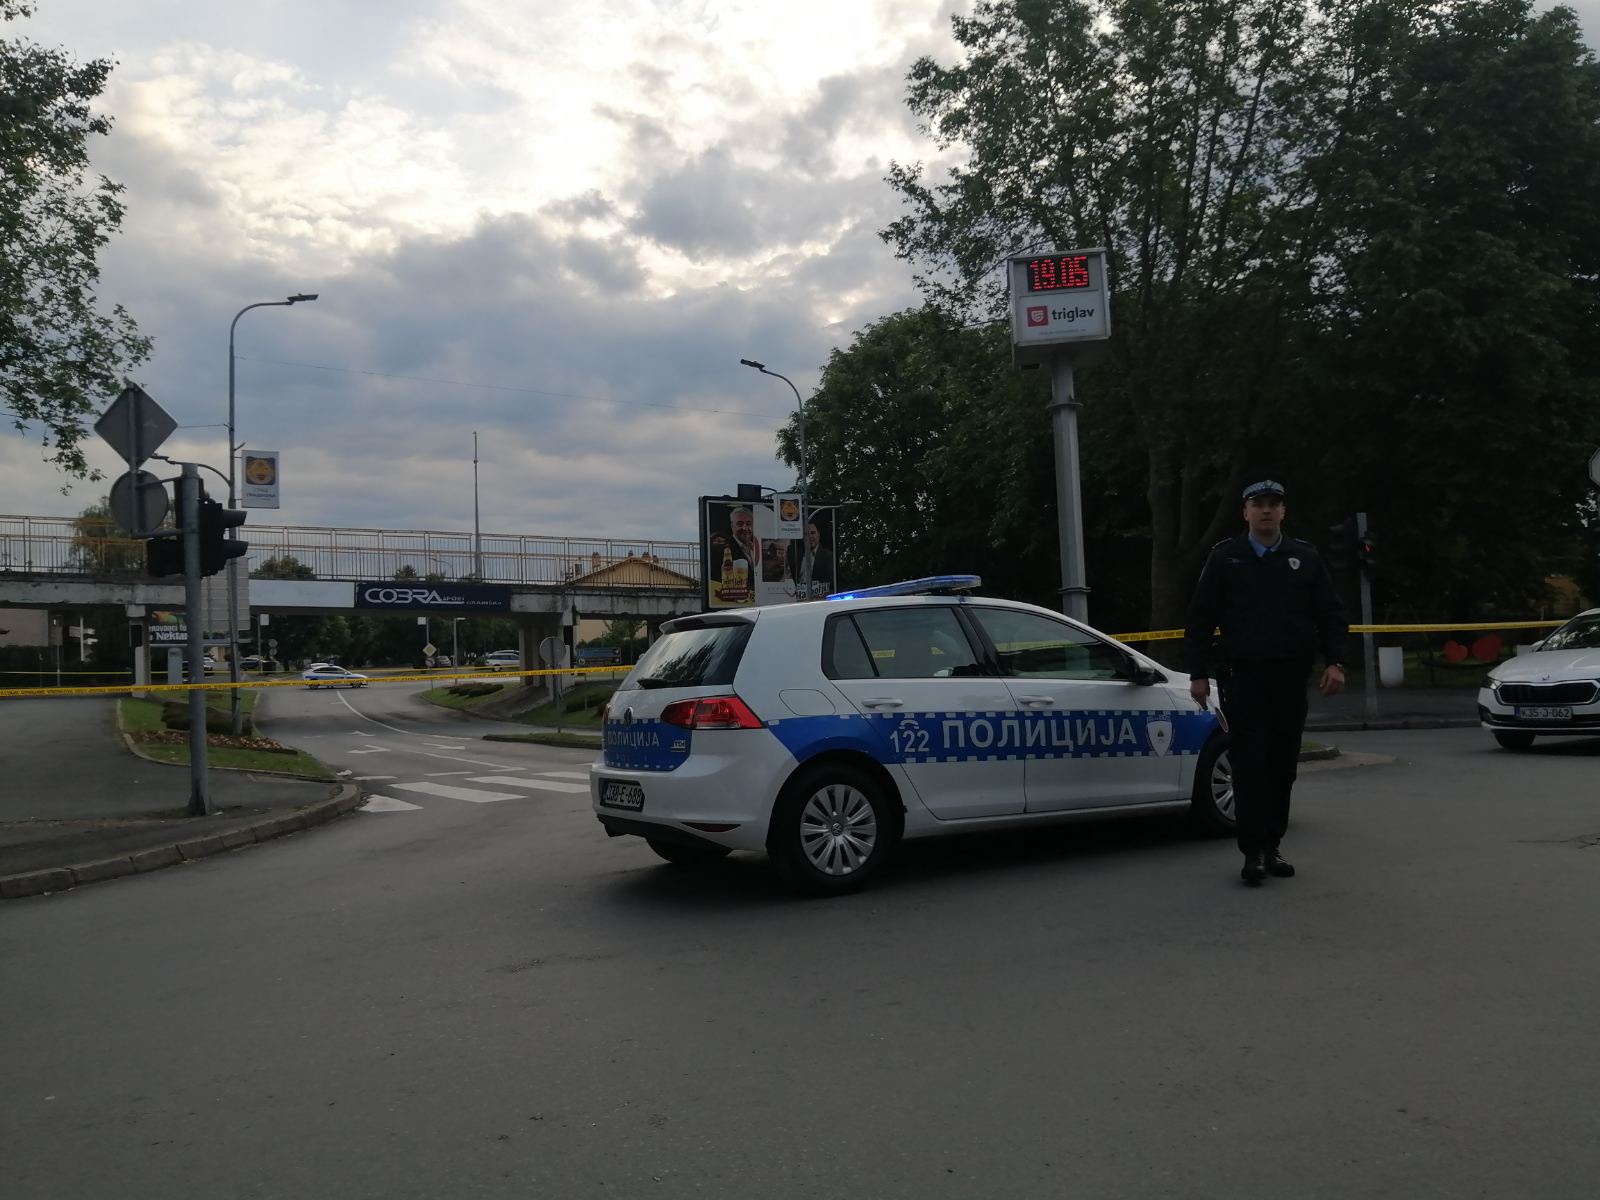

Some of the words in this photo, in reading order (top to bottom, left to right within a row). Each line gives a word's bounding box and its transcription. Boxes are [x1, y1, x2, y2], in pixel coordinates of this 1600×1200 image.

[1052, 306, 1095, 323] triglav
[364, 588, 442, 604] COBRA
[607, 730, 660, 750] ПОЛИЦИЈА
[889, 729, 930, 753] 122
[942, 718, 1138, 751] ПОЛИЦИЈА
